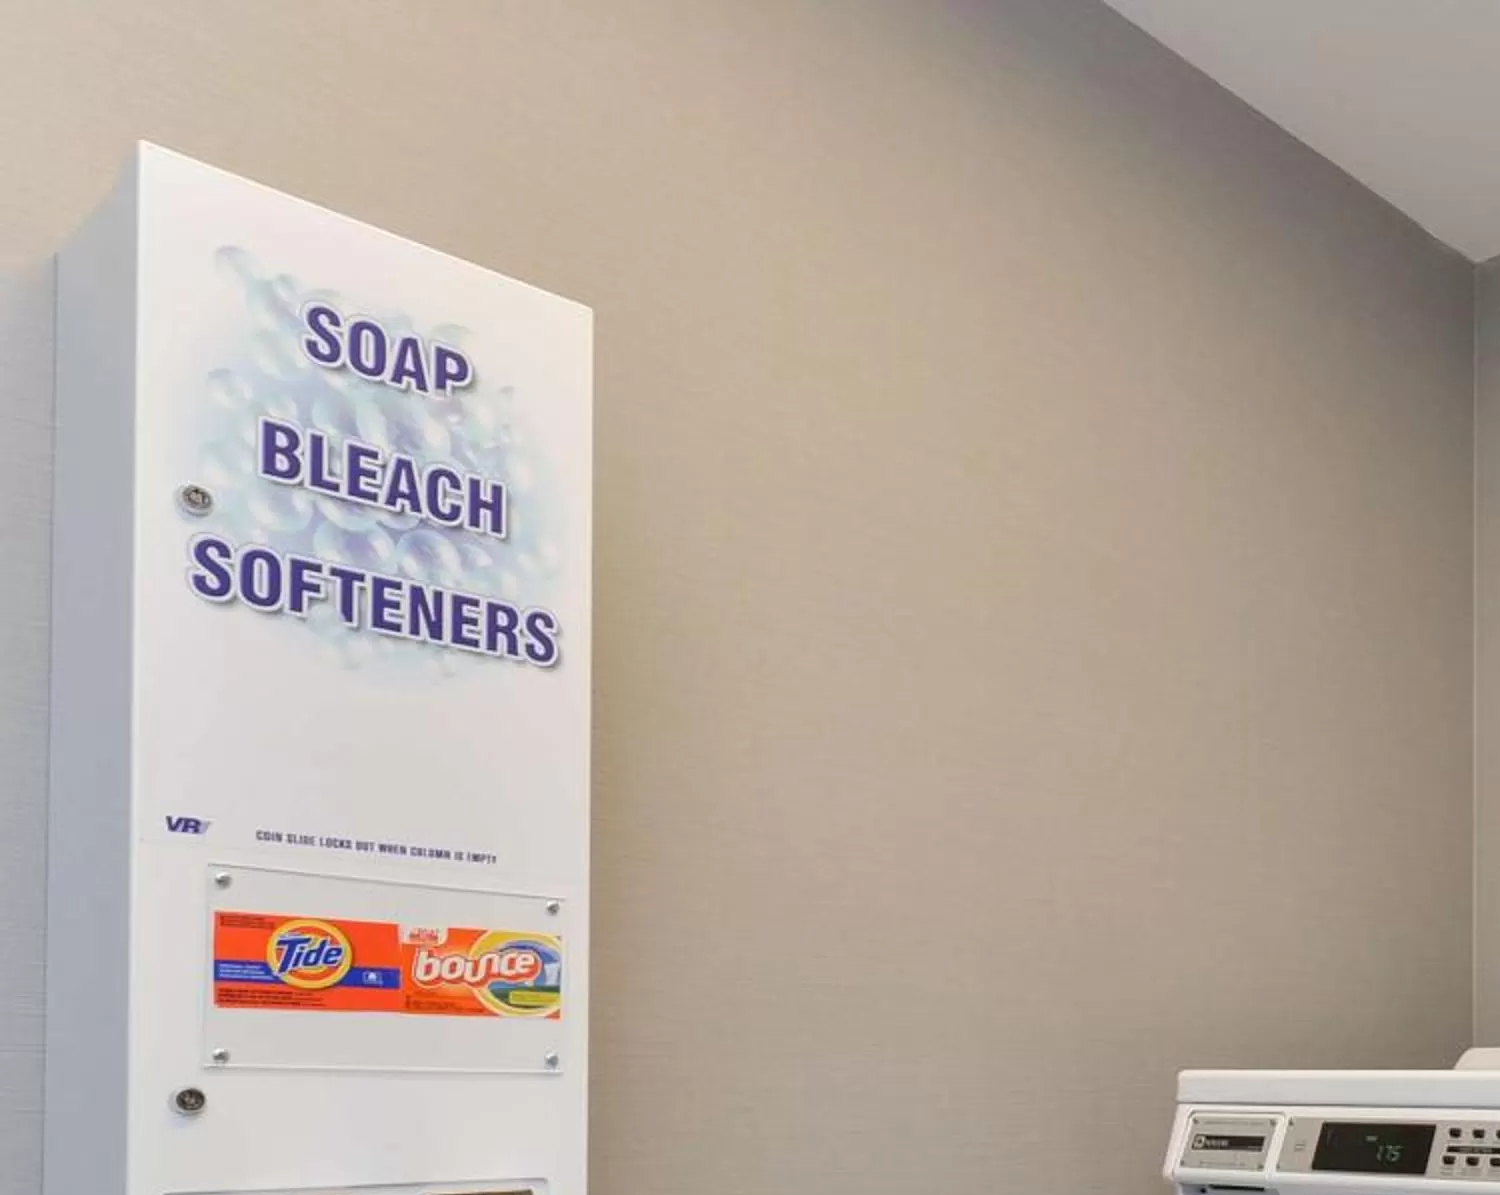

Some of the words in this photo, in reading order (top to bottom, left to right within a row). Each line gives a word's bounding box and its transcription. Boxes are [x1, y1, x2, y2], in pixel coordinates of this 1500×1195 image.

[303, 304, 471, 394] SOAP
[260, 417, 506, 535] BLEACH
[191, 537, 556, 664] SOFTENERS
[255, 829, 283, 844] COIN
[286, 832, 316, 847] SLIDE
[319, 836, 352, 850] LOCKS
[355, 840, 375, 853] OUT
[378, 843, 407, 856] WHEN
[410, 846, 451, 860] COLUMN
[454, 851, 464, 862] IS
[467, 852, 497, 865] EMPTY
[275, 935, 344, 975] Tide
[415, 948, 537, 983] bounce
